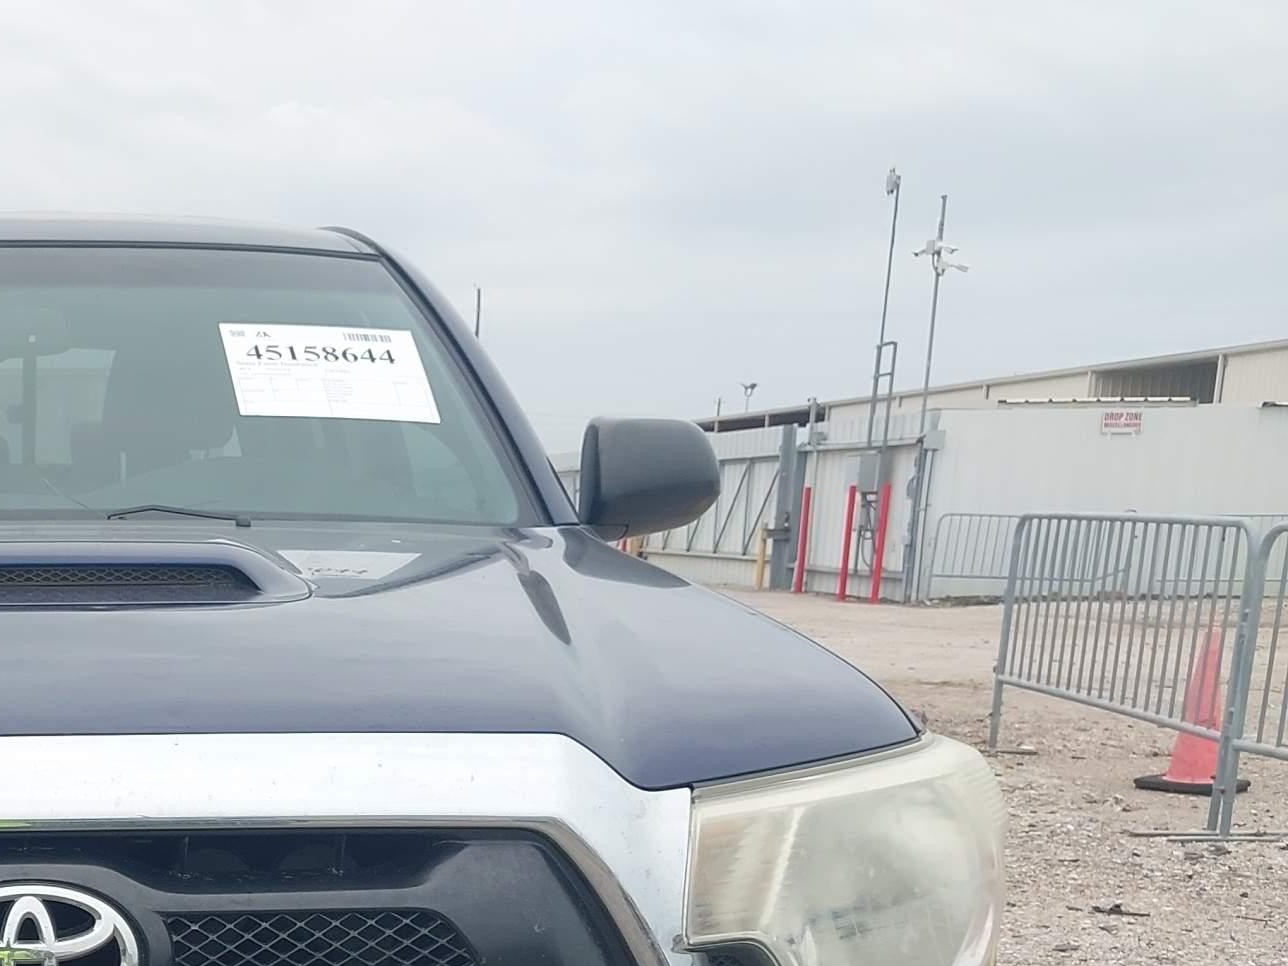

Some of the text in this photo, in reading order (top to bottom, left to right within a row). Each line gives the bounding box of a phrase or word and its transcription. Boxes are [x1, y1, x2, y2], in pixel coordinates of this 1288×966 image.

[246, 344, 396, 364] 45158644
[1104, 411, 1142, 421] DROP ZONE
